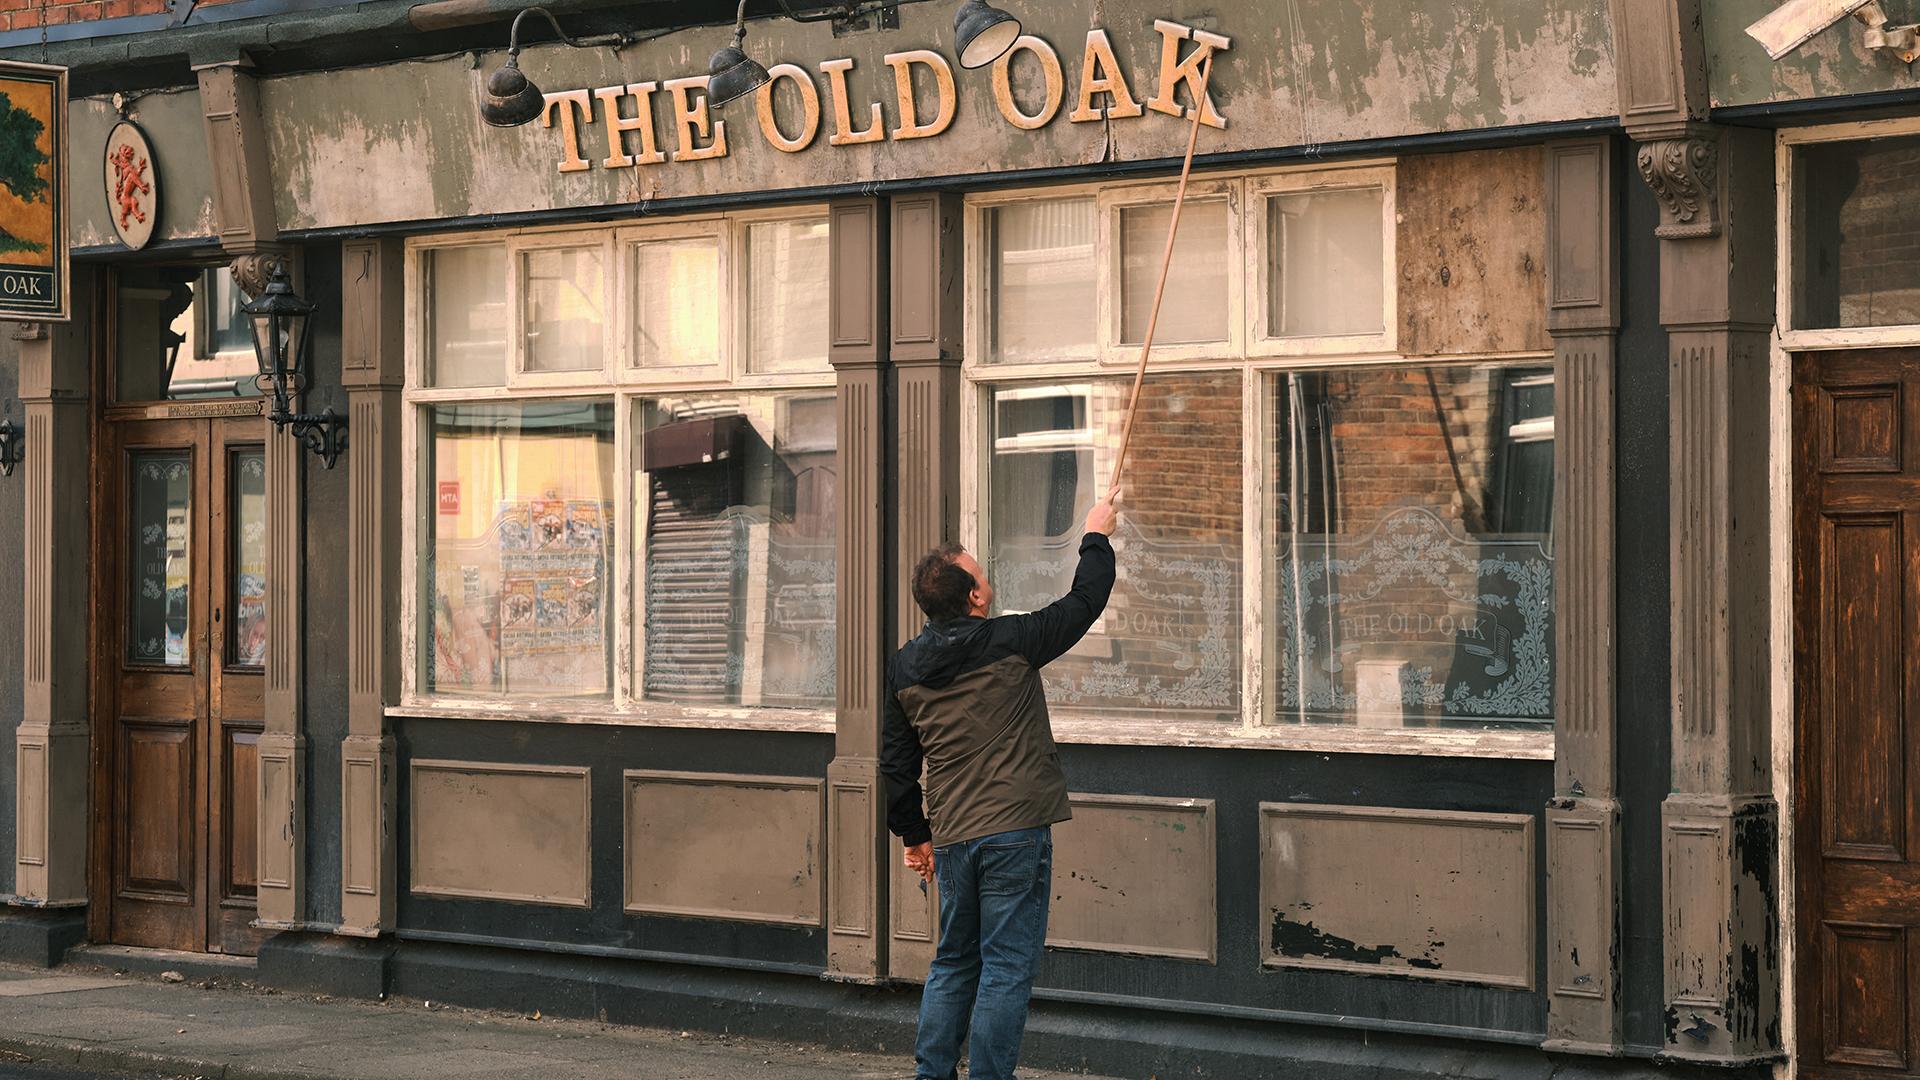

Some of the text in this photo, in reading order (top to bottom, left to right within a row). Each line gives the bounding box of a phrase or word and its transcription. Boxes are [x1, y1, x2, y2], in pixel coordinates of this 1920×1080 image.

[542, 18, 1231, 174] THE OLD OAK
[3, 275, 41, 295] OAK
[1133, 611, 1175, 638] OAK
[1339, 612, 1487, 641] THE OLD OAK
